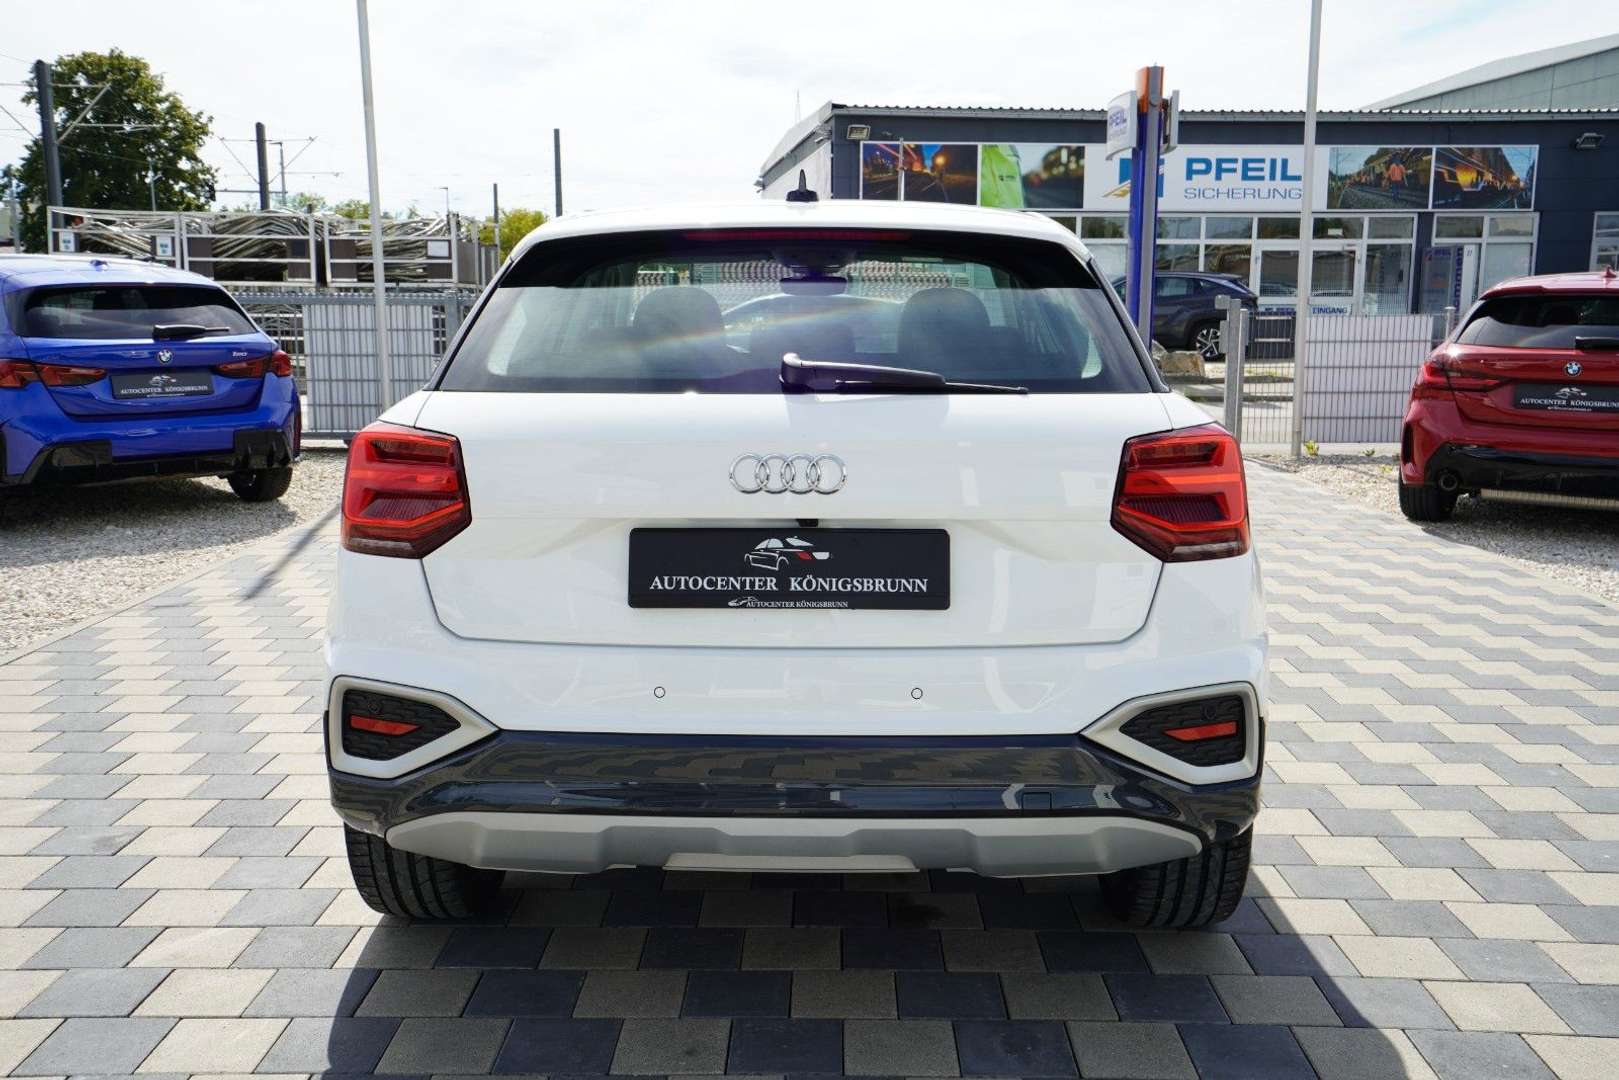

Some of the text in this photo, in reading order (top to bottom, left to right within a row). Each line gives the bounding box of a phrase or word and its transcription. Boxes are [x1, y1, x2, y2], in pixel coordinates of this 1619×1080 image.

[1185, 157, 1303, 181] PFEIL
[1183, 187, 1303, 200] SICHERUNG
[650, 575, 928, 592] AUTOCENTER KÖNIGSBRUNN
[796, 600, 848, 608] KÖNIGSBRUNN
